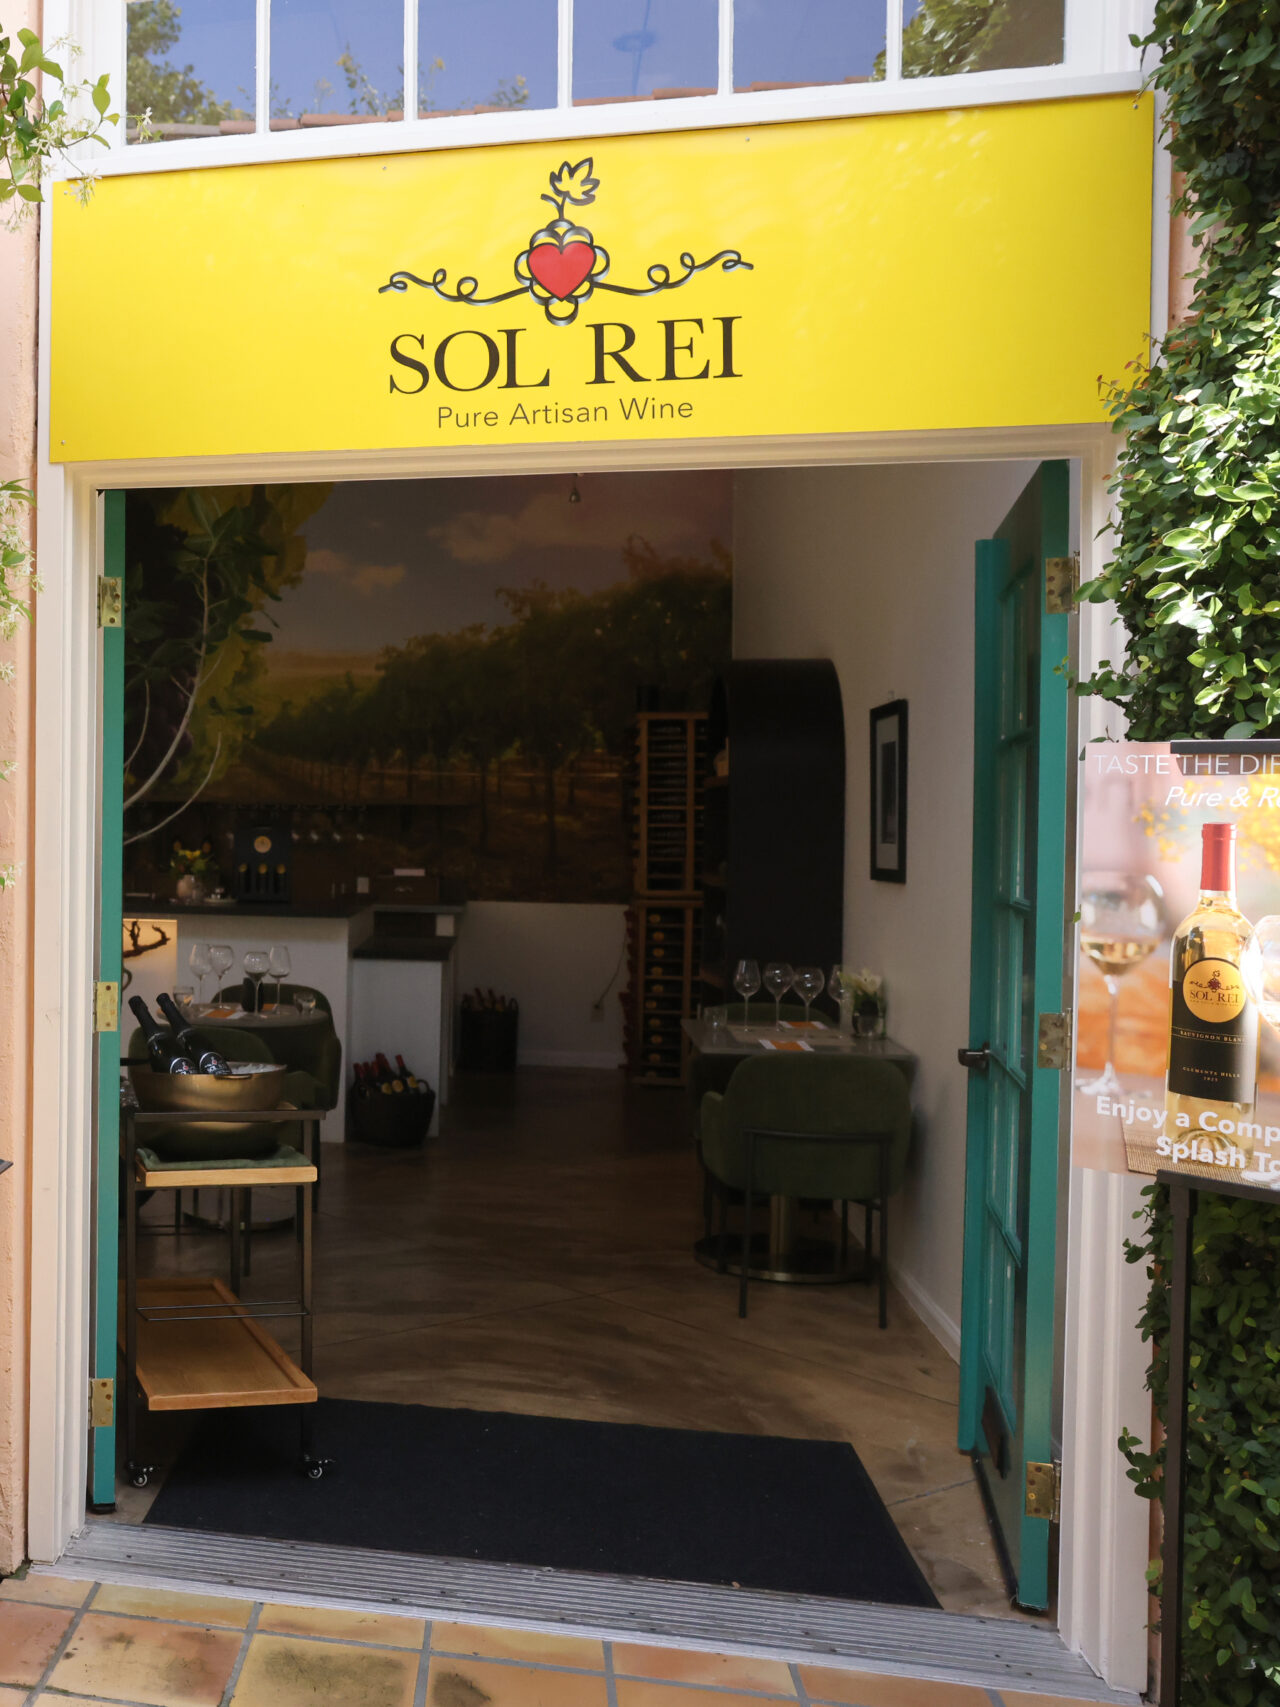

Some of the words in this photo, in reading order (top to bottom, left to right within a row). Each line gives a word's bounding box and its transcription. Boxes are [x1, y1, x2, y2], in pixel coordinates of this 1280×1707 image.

[389, 328, 550, 395] SOL
[585, 315, 743, 385] REI
[437, 406, 499, 429] Pure
[509, 401, 608, 426] Artisan
[619, 397, 694, 421] Wine
[1092, 754, 1170, 775] TASTE
[1177, 754, 1230, 775] THE
[1165, 786, 1223, 807] Pure
[1229, 786, 1251, 808] &
[1190, 990, 1213, 1001] SOL
[1180, 1030, 1221, 1041] SAUVIGNON
[1096, 1095, 1168, 1129] Enjoy
[1175, 1112, 1190, 1128] a
[1198, 1111, 1280, 1148] Comp
[1156, 1135, 1246, 1169] Splash
